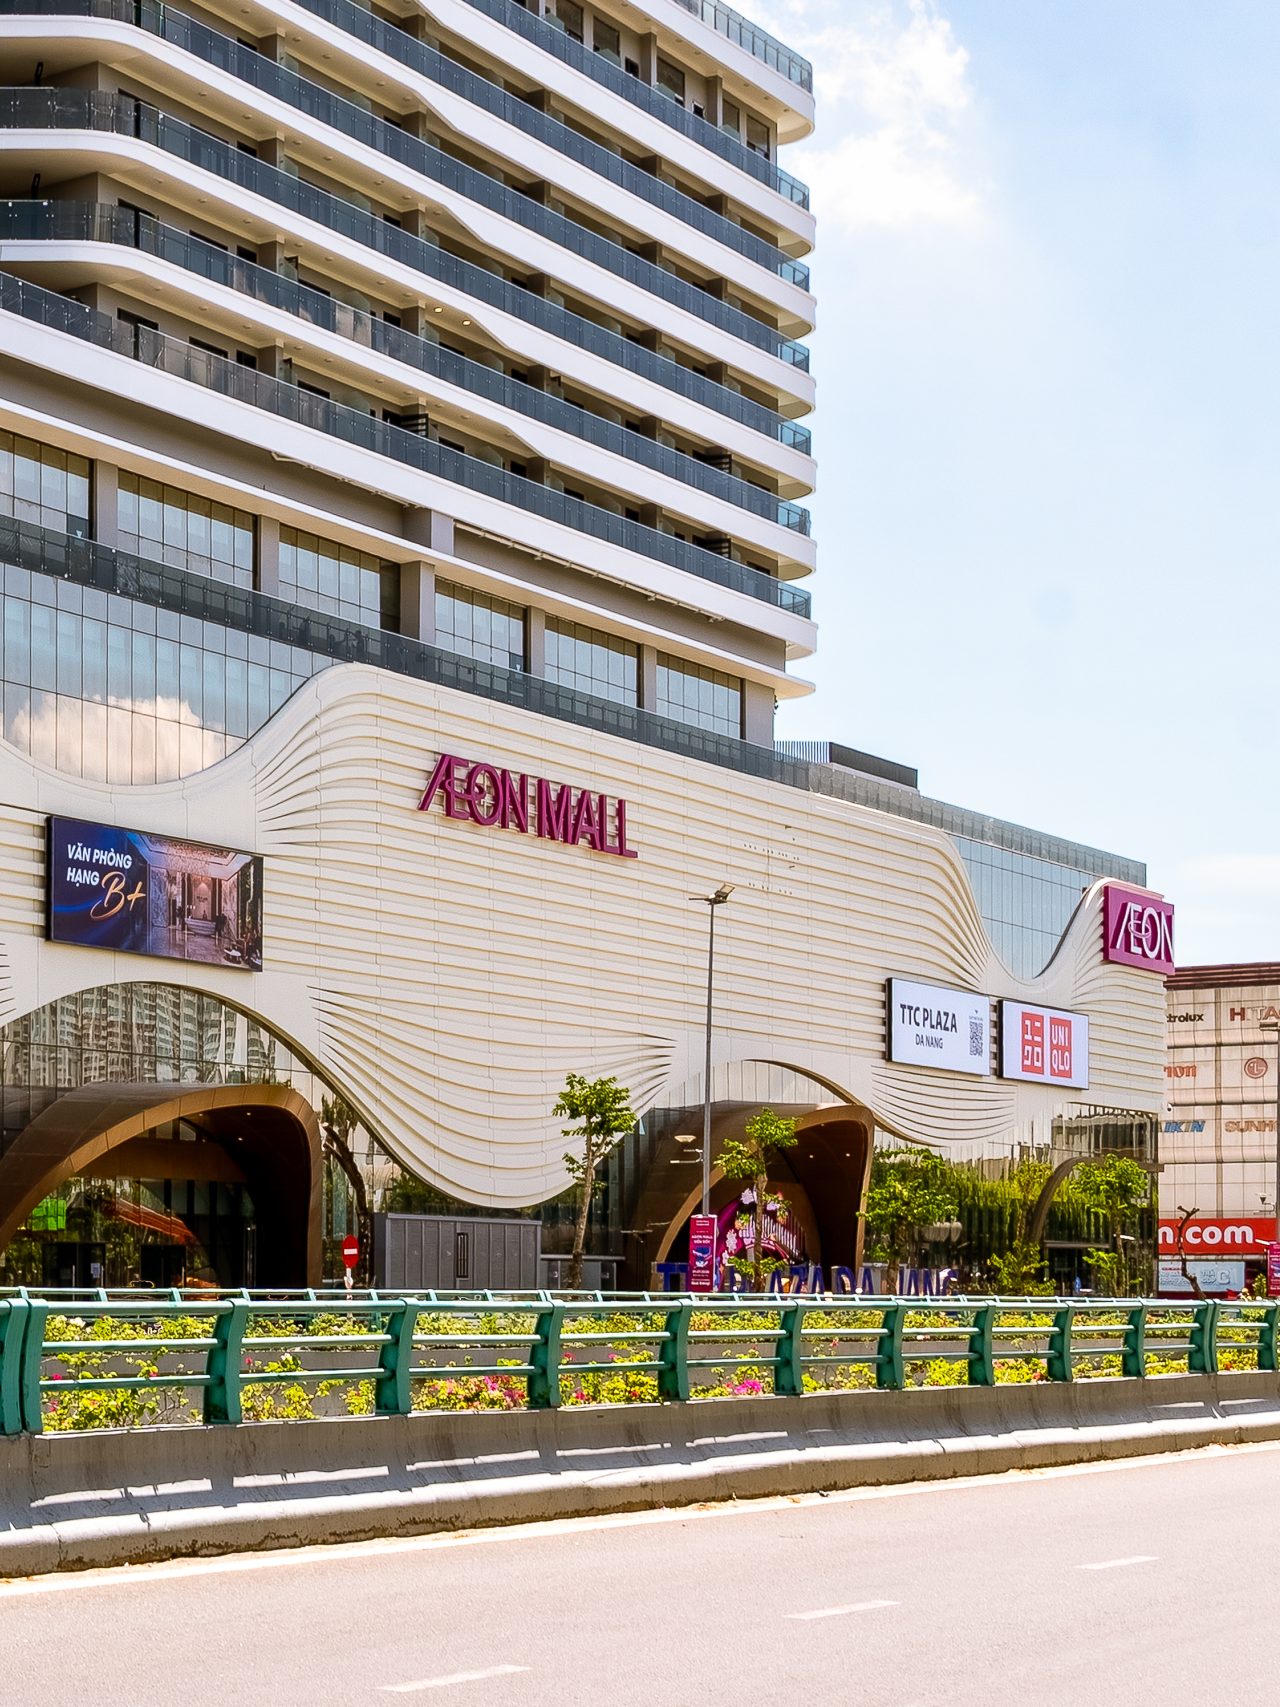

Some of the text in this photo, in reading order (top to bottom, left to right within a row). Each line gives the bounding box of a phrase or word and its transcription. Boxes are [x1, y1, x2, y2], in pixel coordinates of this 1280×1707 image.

[537, 777, 638, 859] MALL
[67, 842, 132, 869] VĂN PHÒNG
[66, 866, 146, 920] HẠNG B+
[899, 1003, 958, 1034] TTC PLAZA
[1167, 1012, 1205, 1023] trolux
[915, 1033, 944, 1049] DA NANG
[1051, 1024, 1069, 1047] UNI
[1051, 1049, 1070, 1073] QLO
[1224, 1120, 1278, 1133] SUNH
